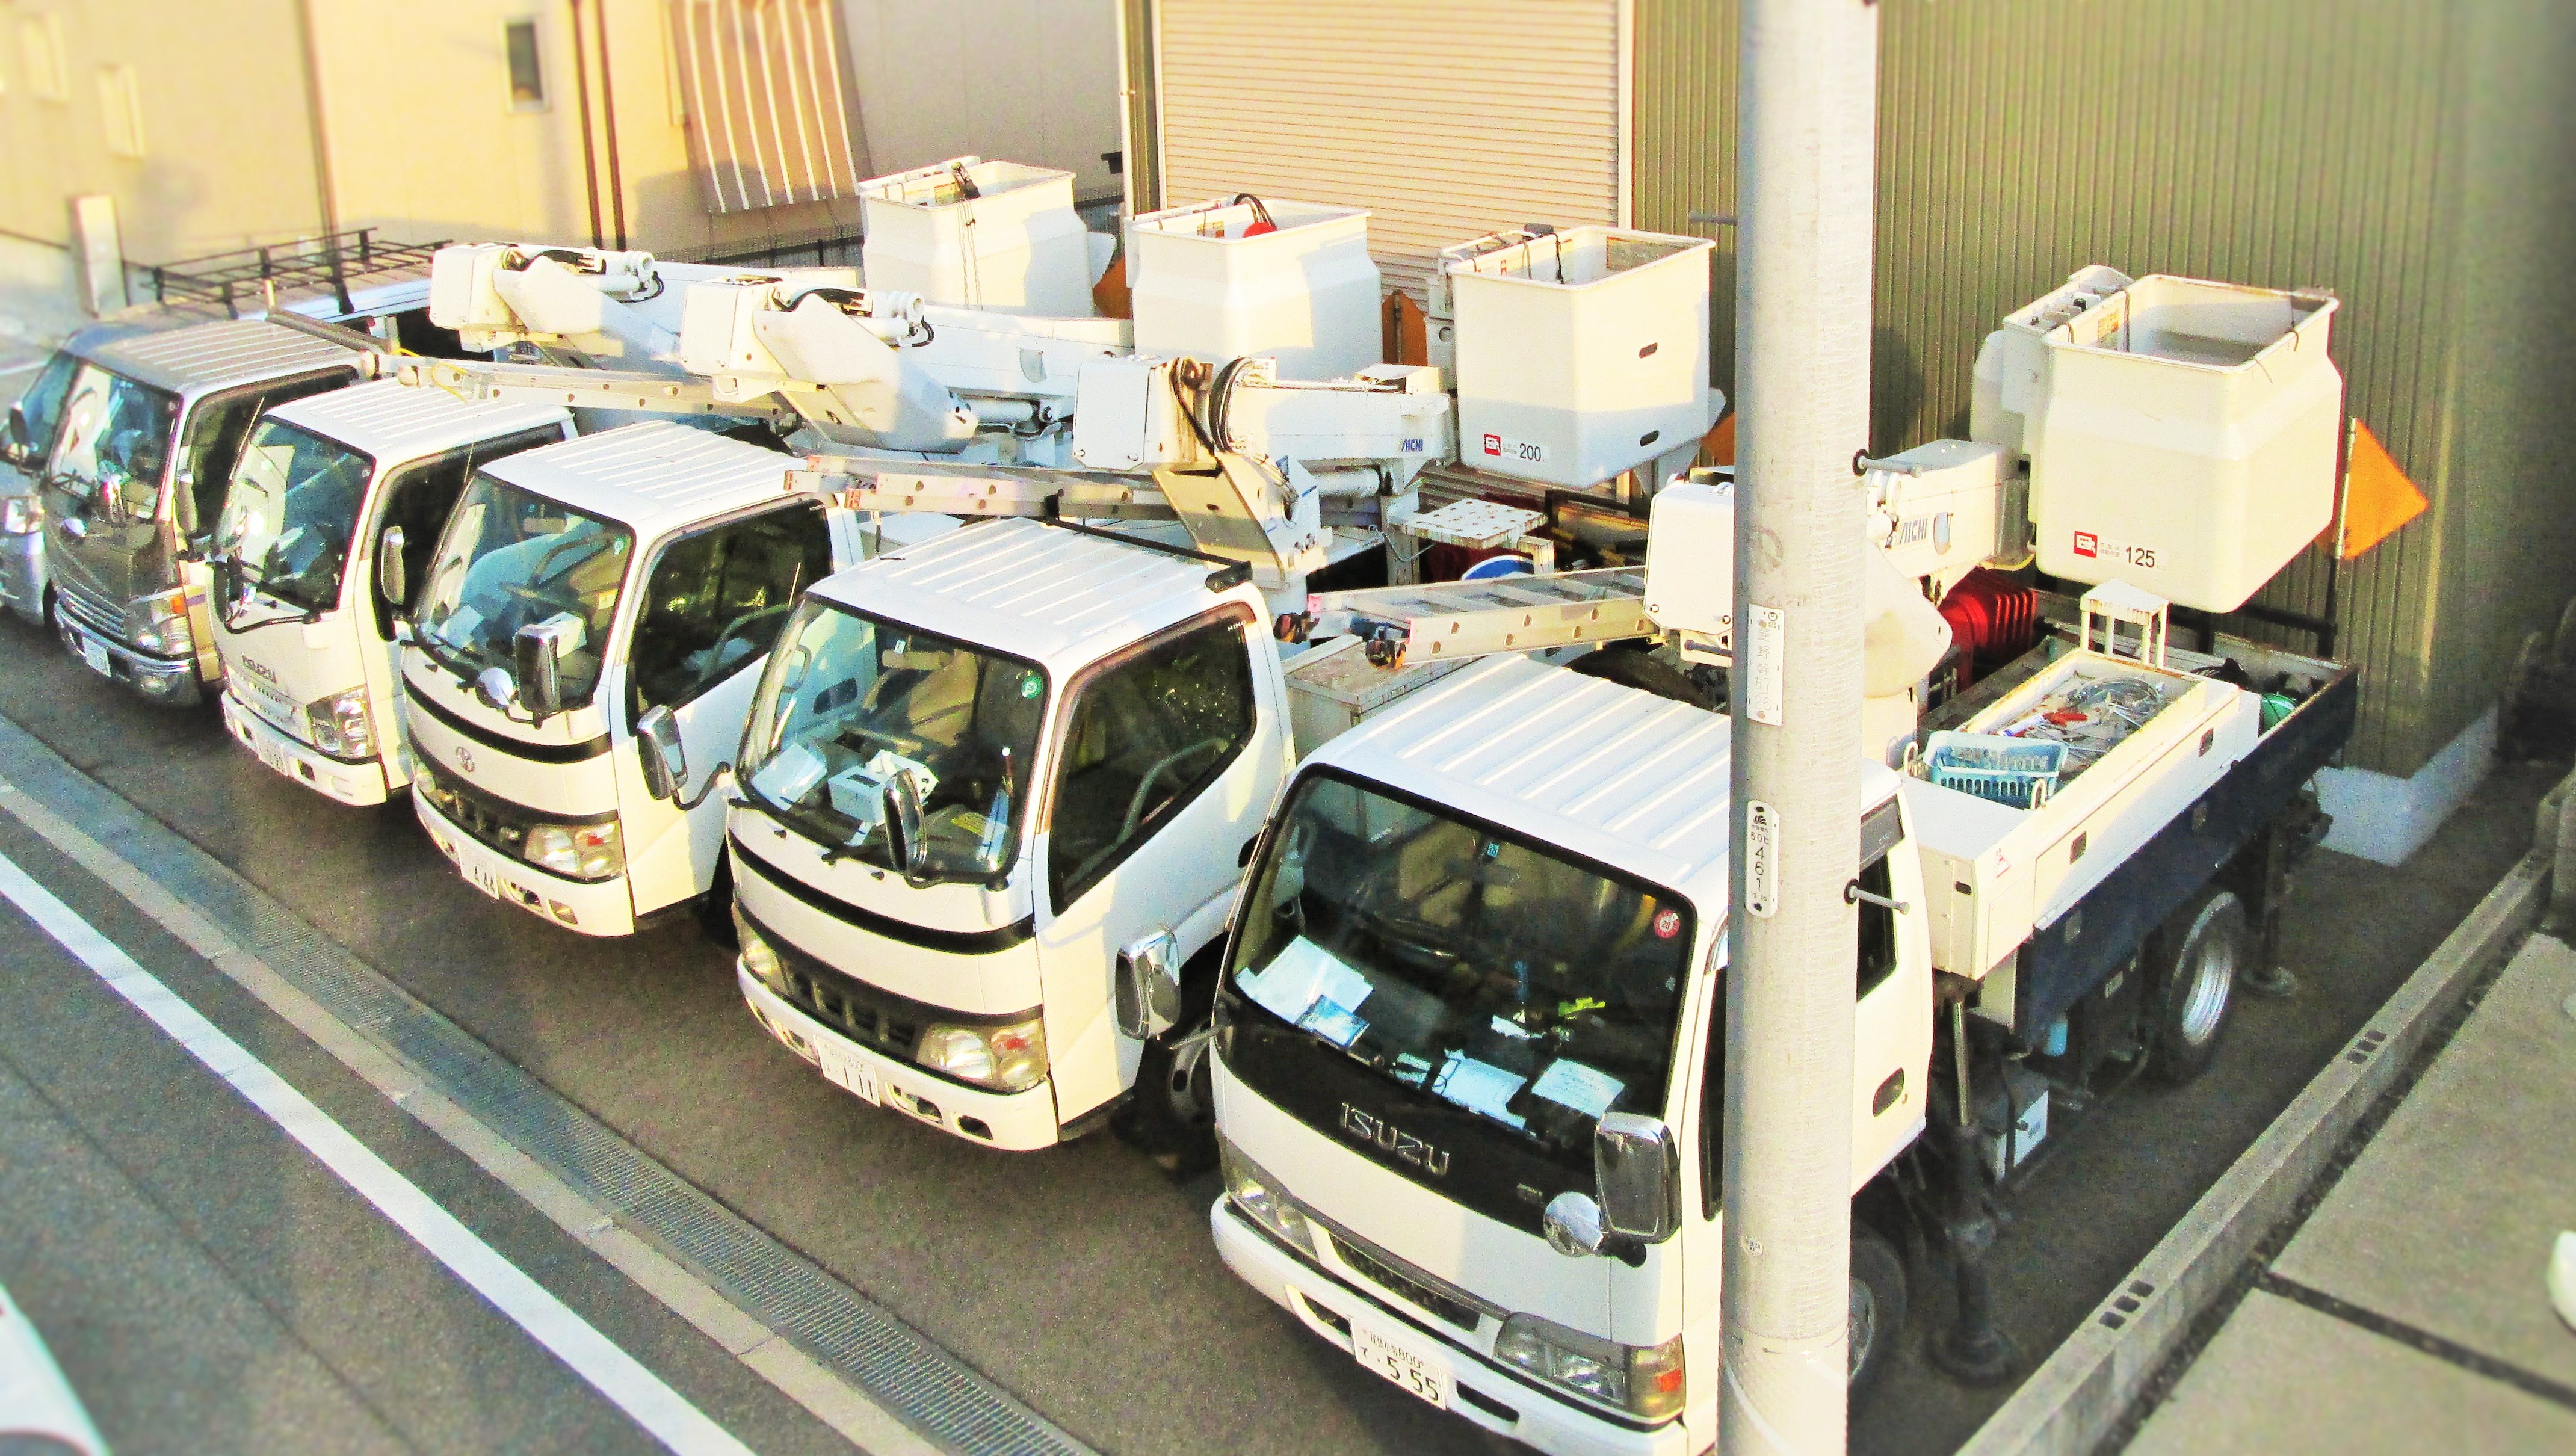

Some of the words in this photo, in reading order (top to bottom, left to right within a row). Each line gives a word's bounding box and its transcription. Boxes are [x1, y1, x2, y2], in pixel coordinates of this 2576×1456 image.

[1519, 443, 1542, 461] 200
[2126, 546, 2155, 568] 125
[242, 655, 277, 684] ISUZU
[1339, 1102, 1450, 1176] ISUZU
